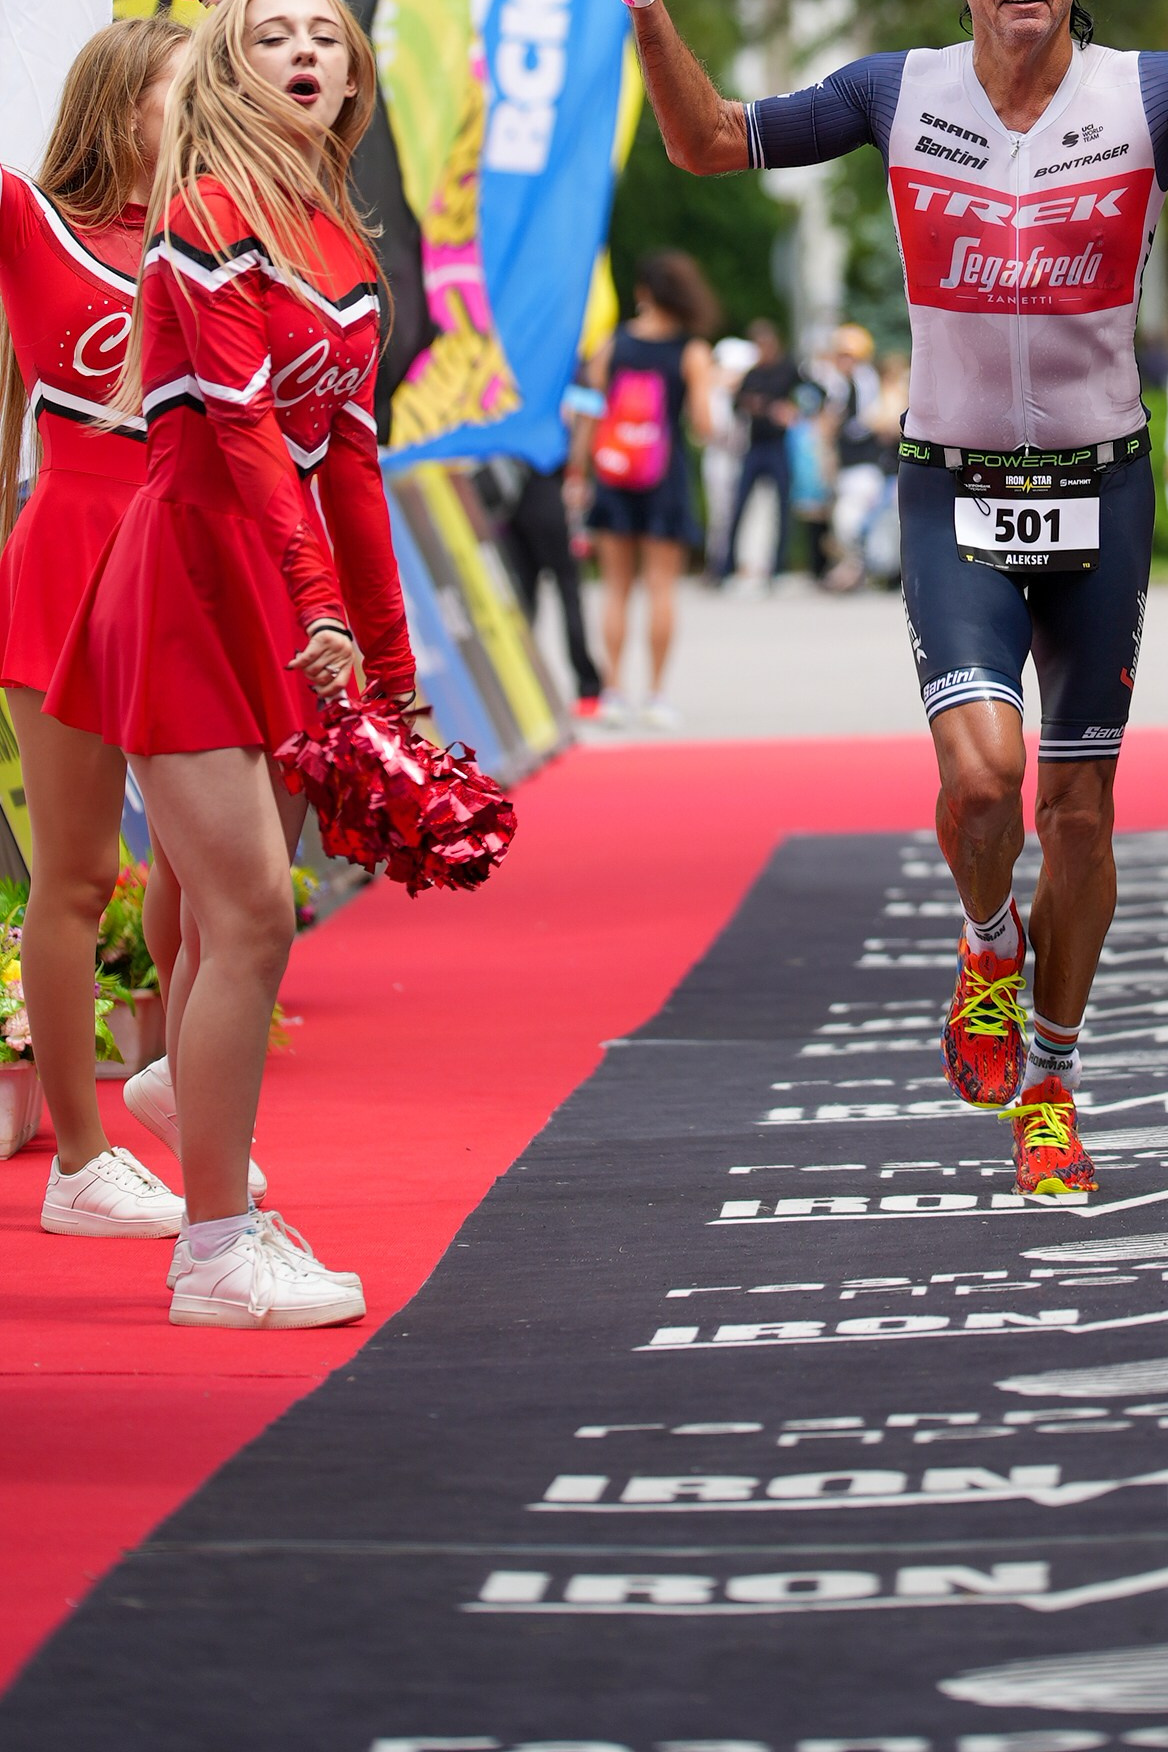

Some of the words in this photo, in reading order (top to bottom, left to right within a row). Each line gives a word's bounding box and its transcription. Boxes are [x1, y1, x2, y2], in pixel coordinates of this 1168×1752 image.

[1081, 123, 1094, 132] UCI
[1082, 125, 1104, 138] WORLD
[1083, 133, 1100, 143] TEAM
[914, 135, 990, 170] Santini
[1033, 143, 1130, 179] BONTRAGER
[908, 182, 1130, 229] TREK
[939, 235, 1103, 293] Segafredo
[987, 294, 1053, 305] ZANETTI
[271, 338, 377, 408] Cool
[967, 450, 1092, 468] POWERUP
[1005, 475, 1024, 485] IRON
[1032, 475, 1052, 485] STAR
[1067, 478, 1092, 486] МАГНИТ
[994, 508, 1060, 543] 501
[1005, 554, 1050, 566] ALEKSEY
[923, 668, 976, 701] Santini
[719, 1191, 1089, 1219] IRON
[647, 1308, 1082, 1346] IRON
[542, 1464, 1063, 1504] IRON
[478, 1560, 1053, 1605] IRON
